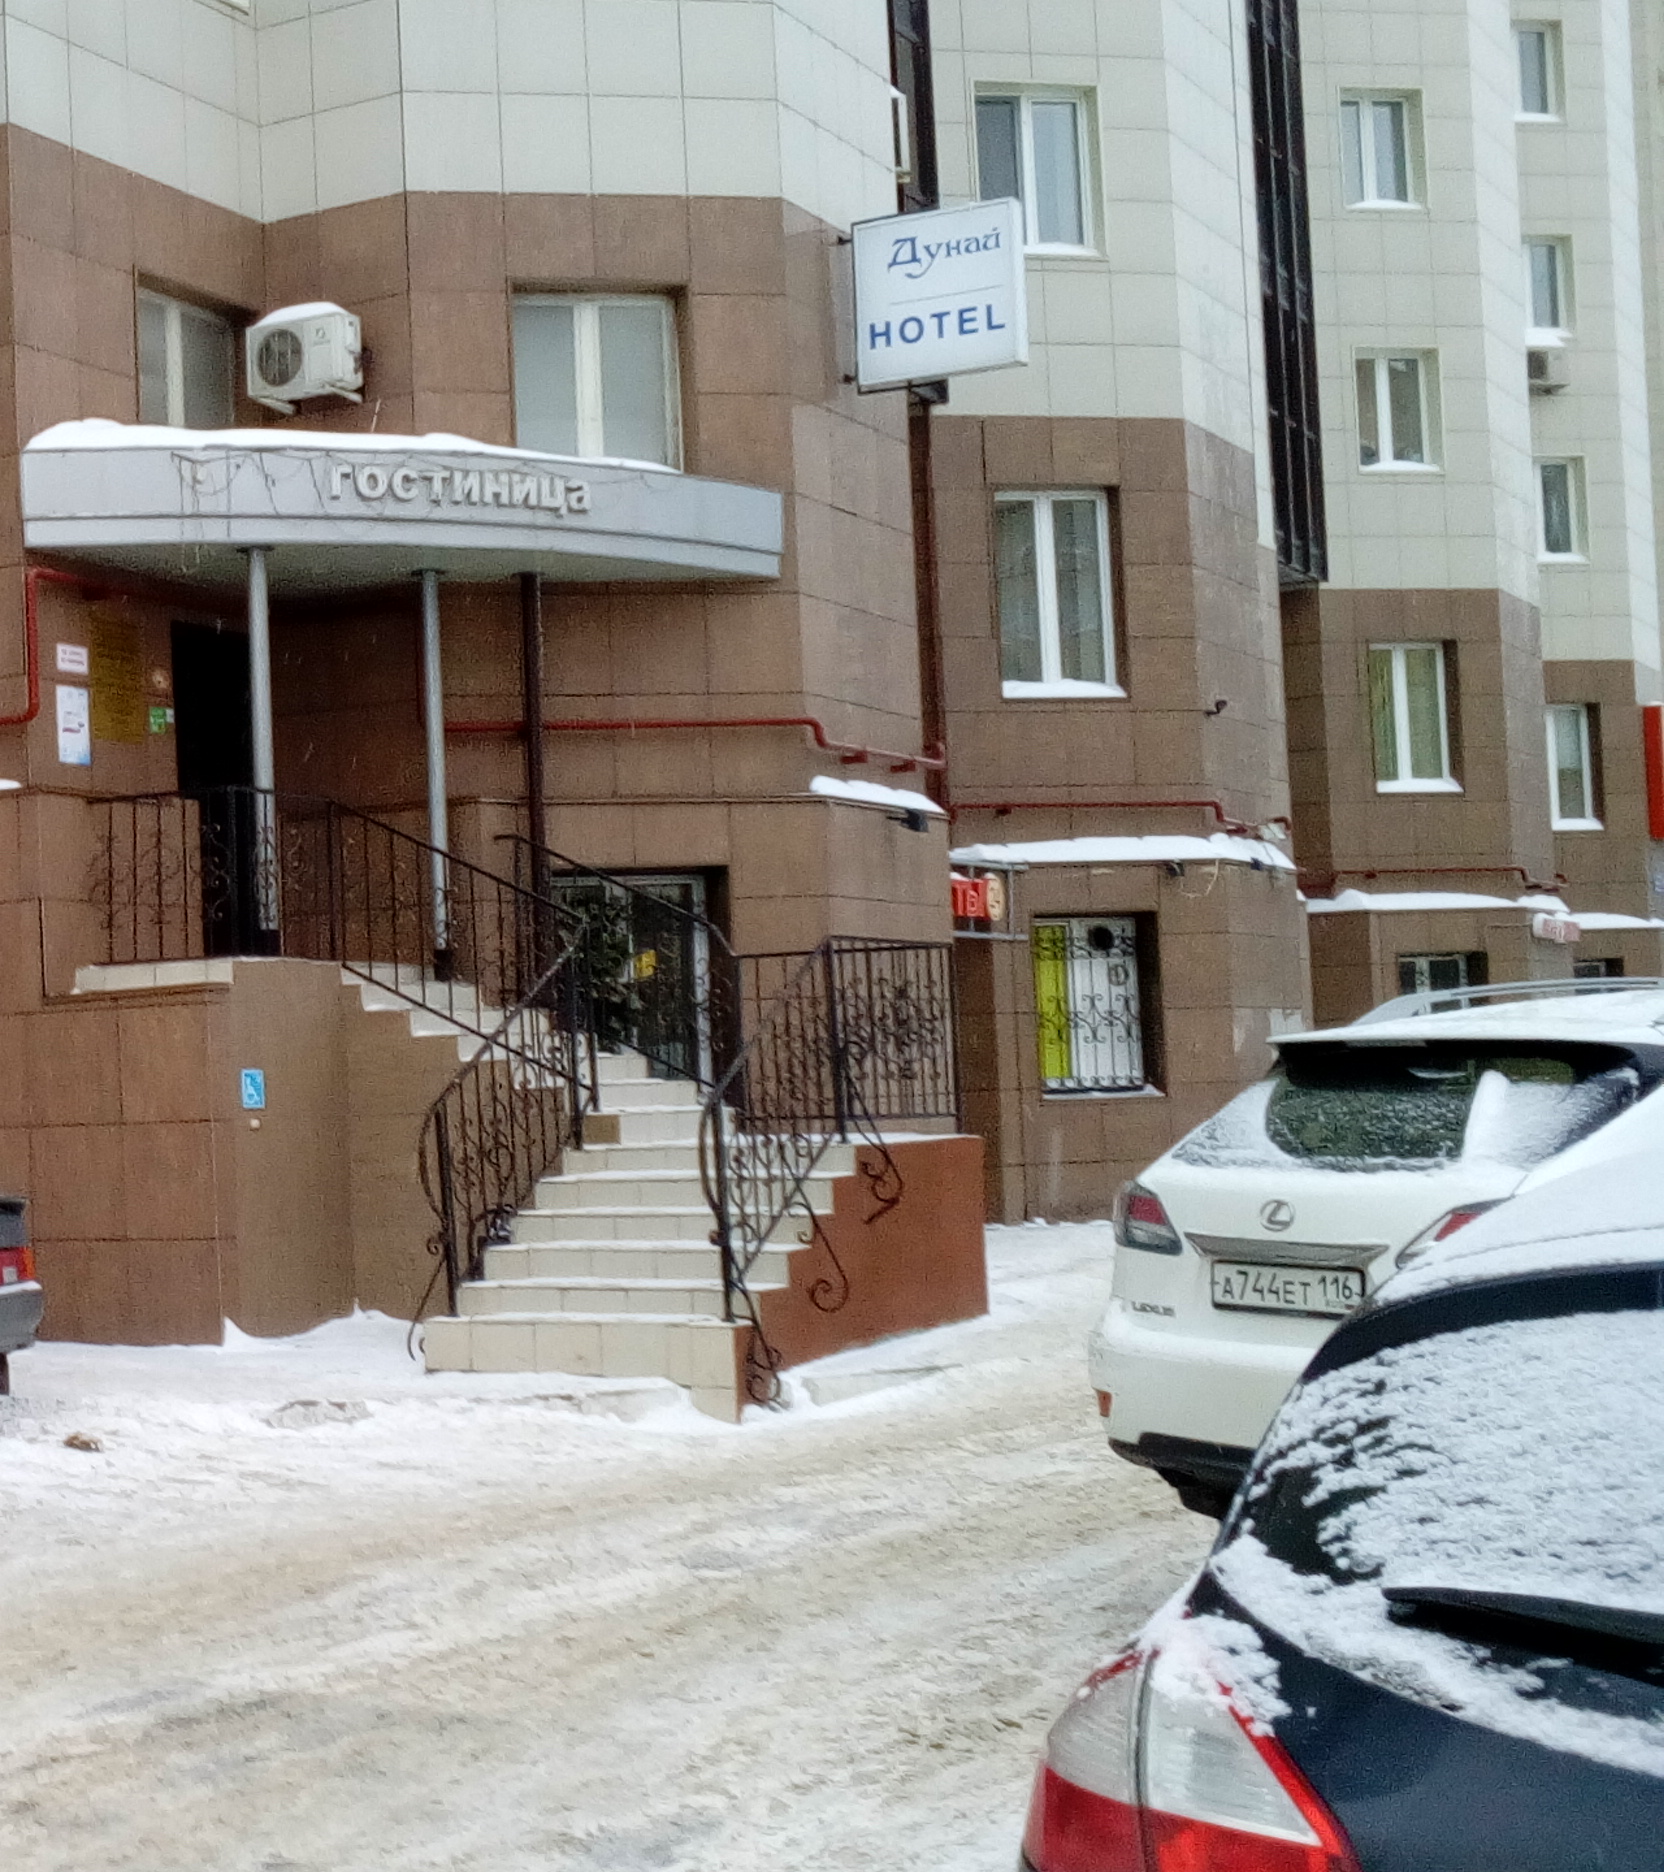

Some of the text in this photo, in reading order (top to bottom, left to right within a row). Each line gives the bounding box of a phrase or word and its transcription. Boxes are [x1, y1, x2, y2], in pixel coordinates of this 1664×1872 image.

[887, 226, 1002, 279] Дунай
[868, 303, 1006, 350] HOTEL
[1220, 1269, 1354, 1306] А744ЕТ 116
